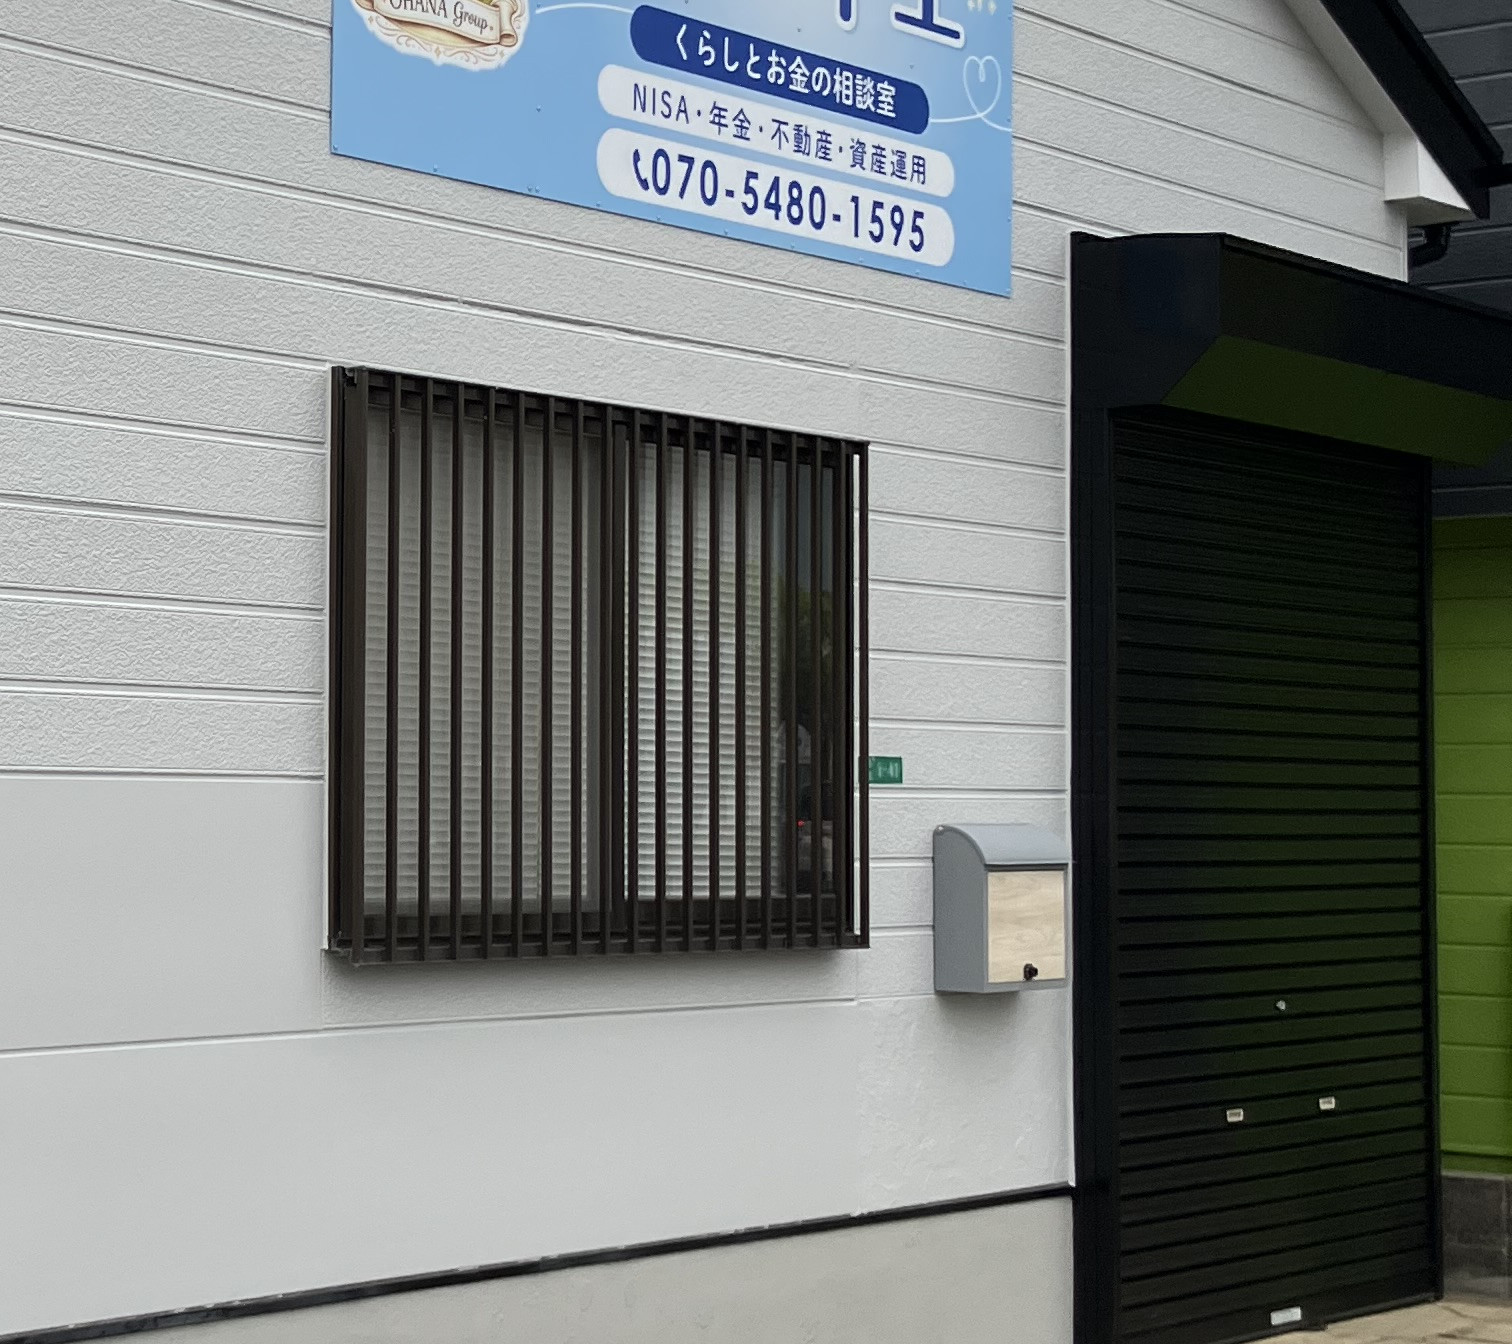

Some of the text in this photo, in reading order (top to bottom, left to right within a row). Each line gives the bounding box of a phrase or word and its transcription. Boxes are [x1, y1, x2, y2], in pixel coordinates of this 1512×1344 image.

[452, 0, 489, 35] Group
[676, 23, 897, 118] くらしとお金の相談室
[633, 82, 927, 186] NISA・年金・不動産・資産運用
[651, 147, 926, 253] 070-5480-1595
